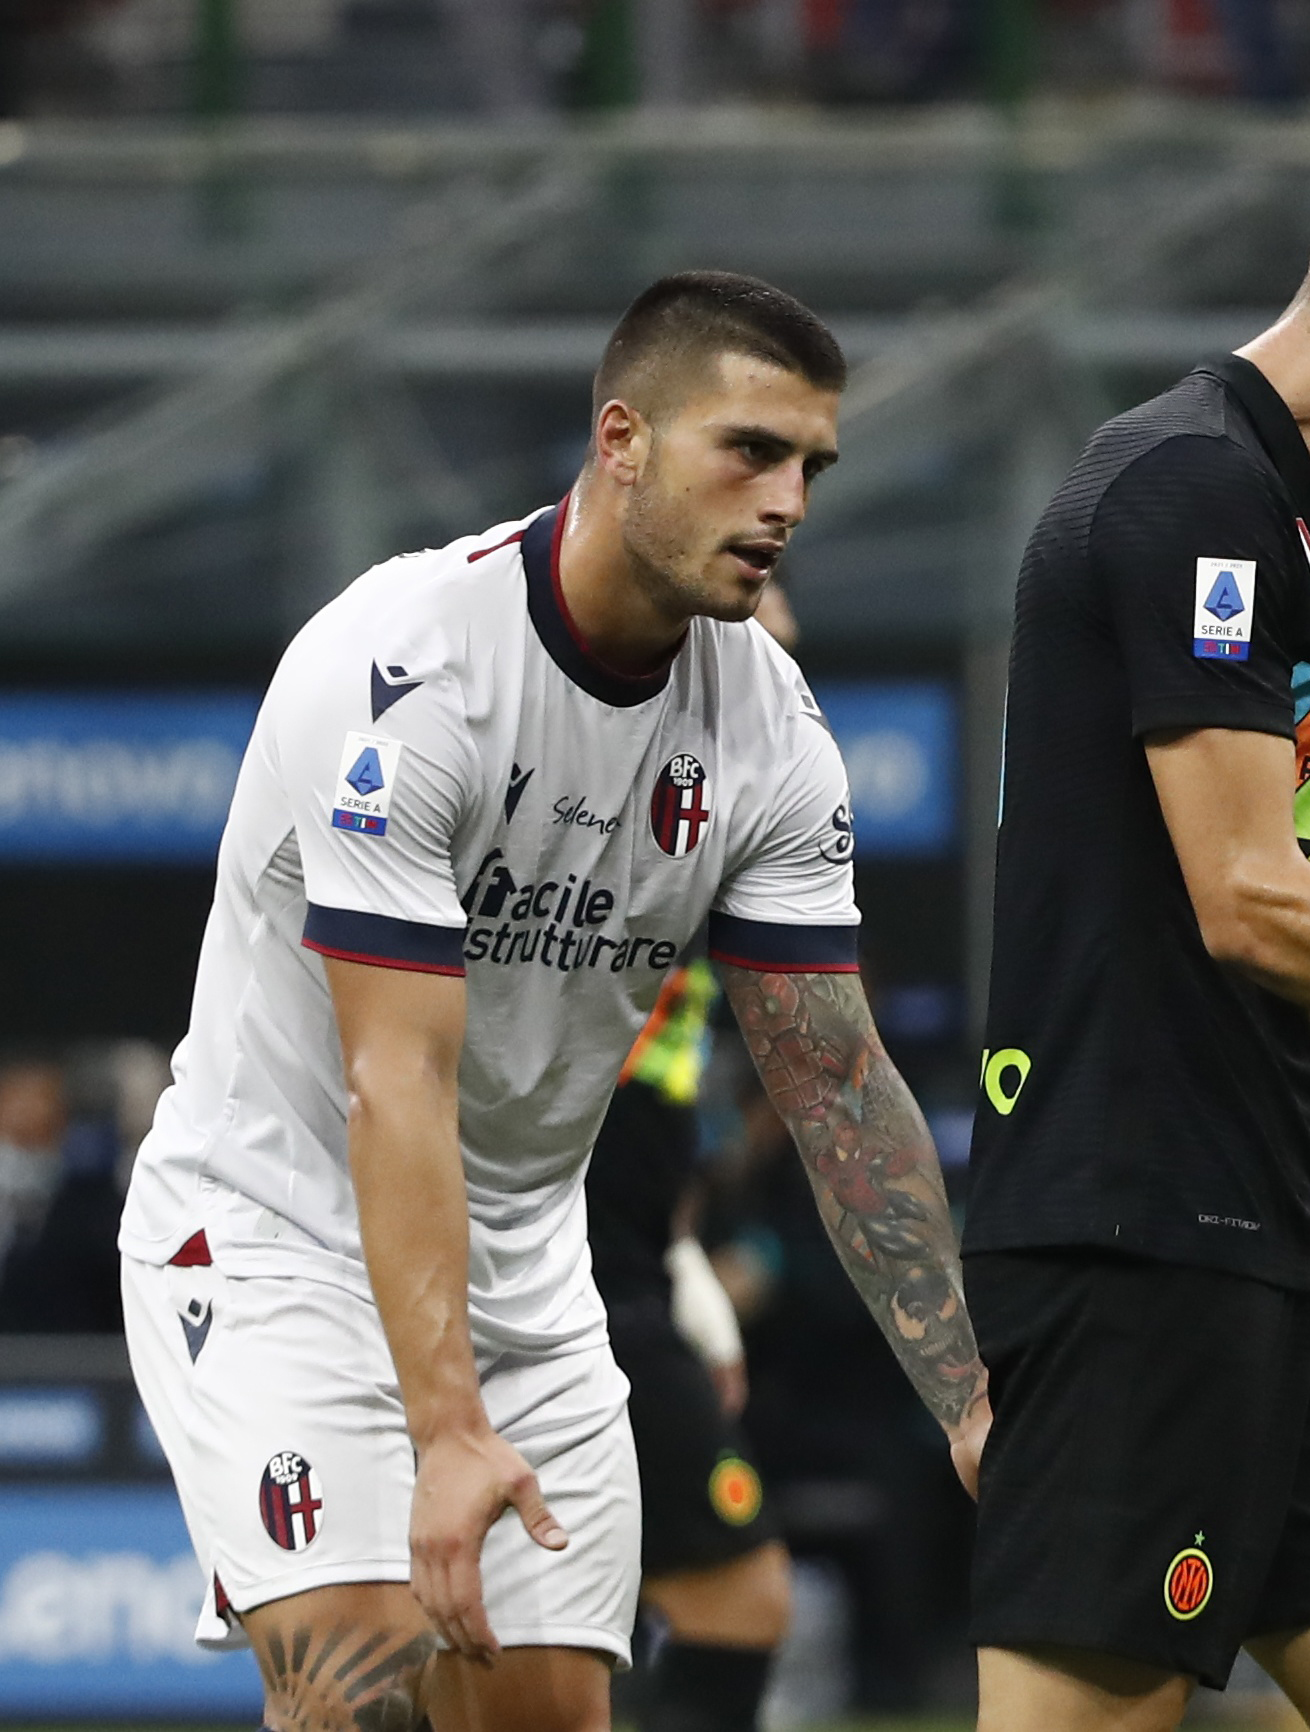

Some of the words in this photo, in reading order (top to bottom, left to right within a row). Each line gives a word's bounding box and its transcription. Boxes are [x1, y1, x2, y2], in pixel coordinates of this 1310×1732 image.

[1201, 624, 1234, 637] SERIE
[1235, 627, 1243, 637] A
[668, 755, 701, 780] BFC
[340, 796, 372, 812] SERIE
[372, 803, 382, 814] A
[269, 1452, 303, 1479] BFC
